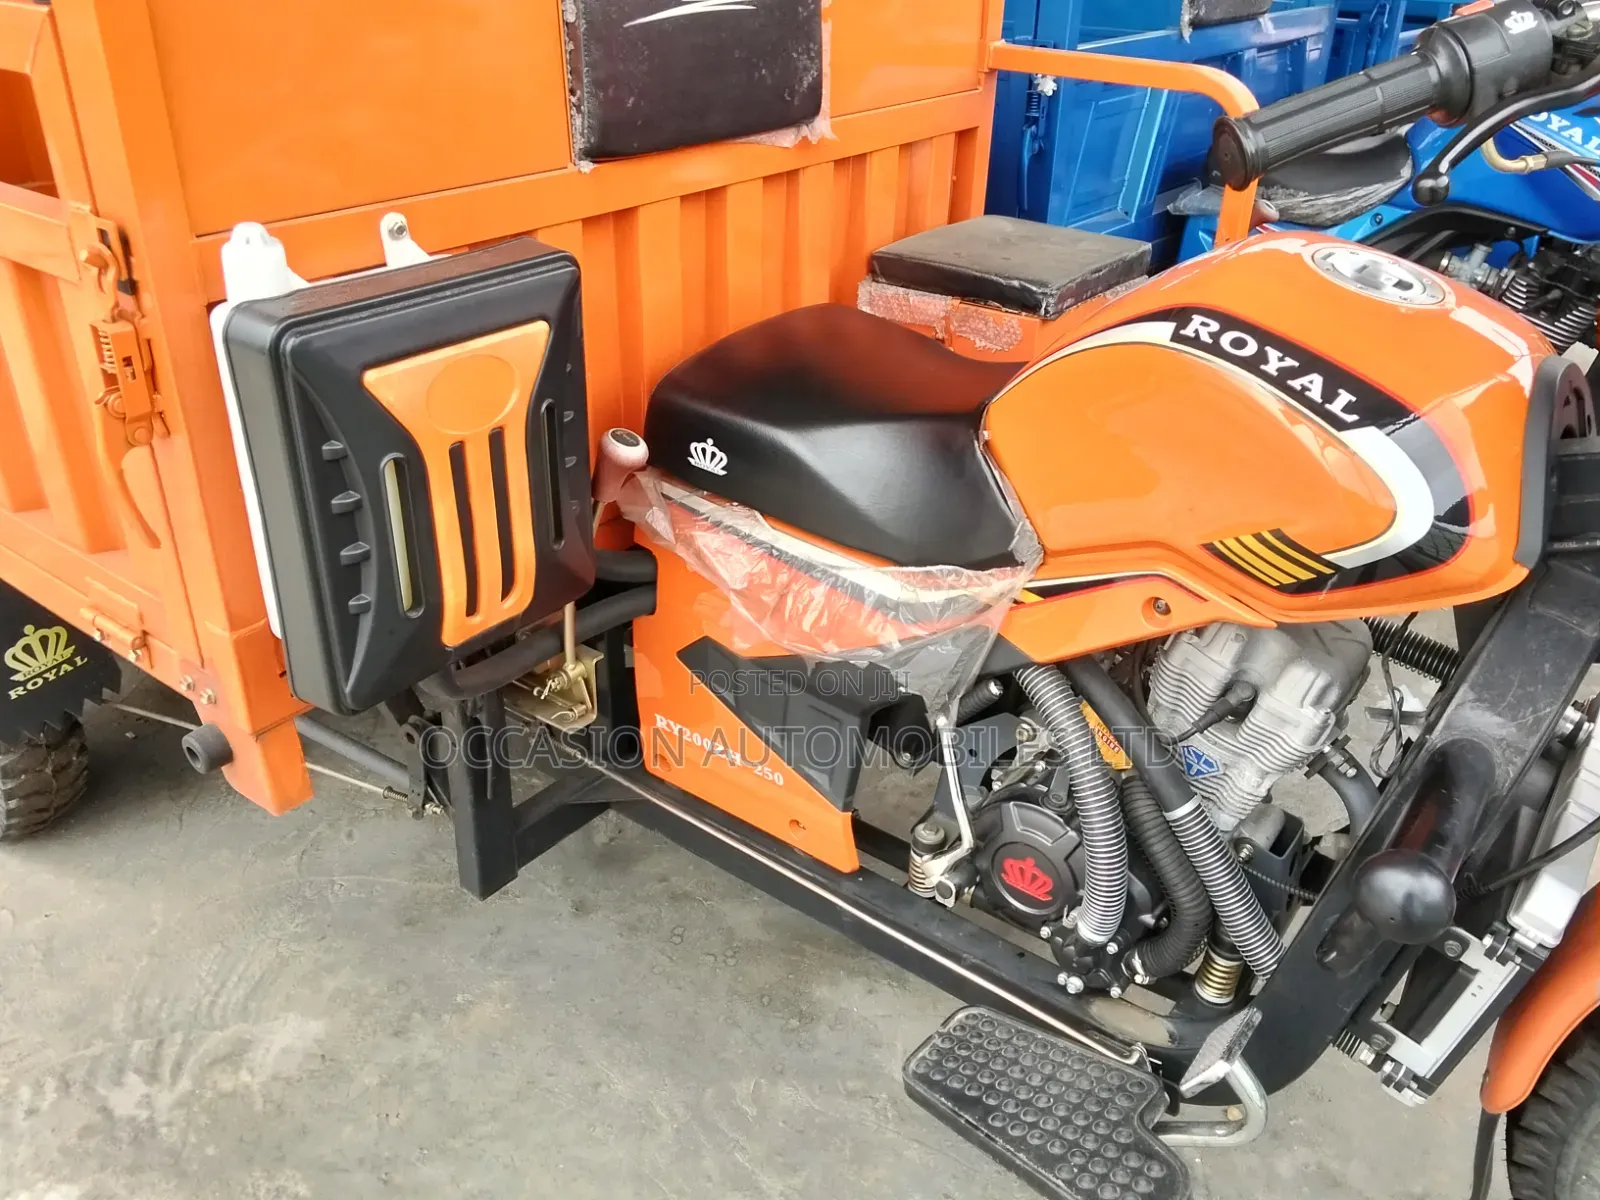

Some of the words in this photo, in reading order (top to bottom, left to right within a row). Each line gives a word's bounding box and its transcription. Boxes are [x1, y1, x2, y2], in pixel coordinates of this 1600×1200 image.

[1528, 111, 1600, 155] OYAL
[1179, 313, 1360, 423] ROYAL
[8, 656, 88, 700] ROYAL
[23, 651, 71, 678] ROYAL
